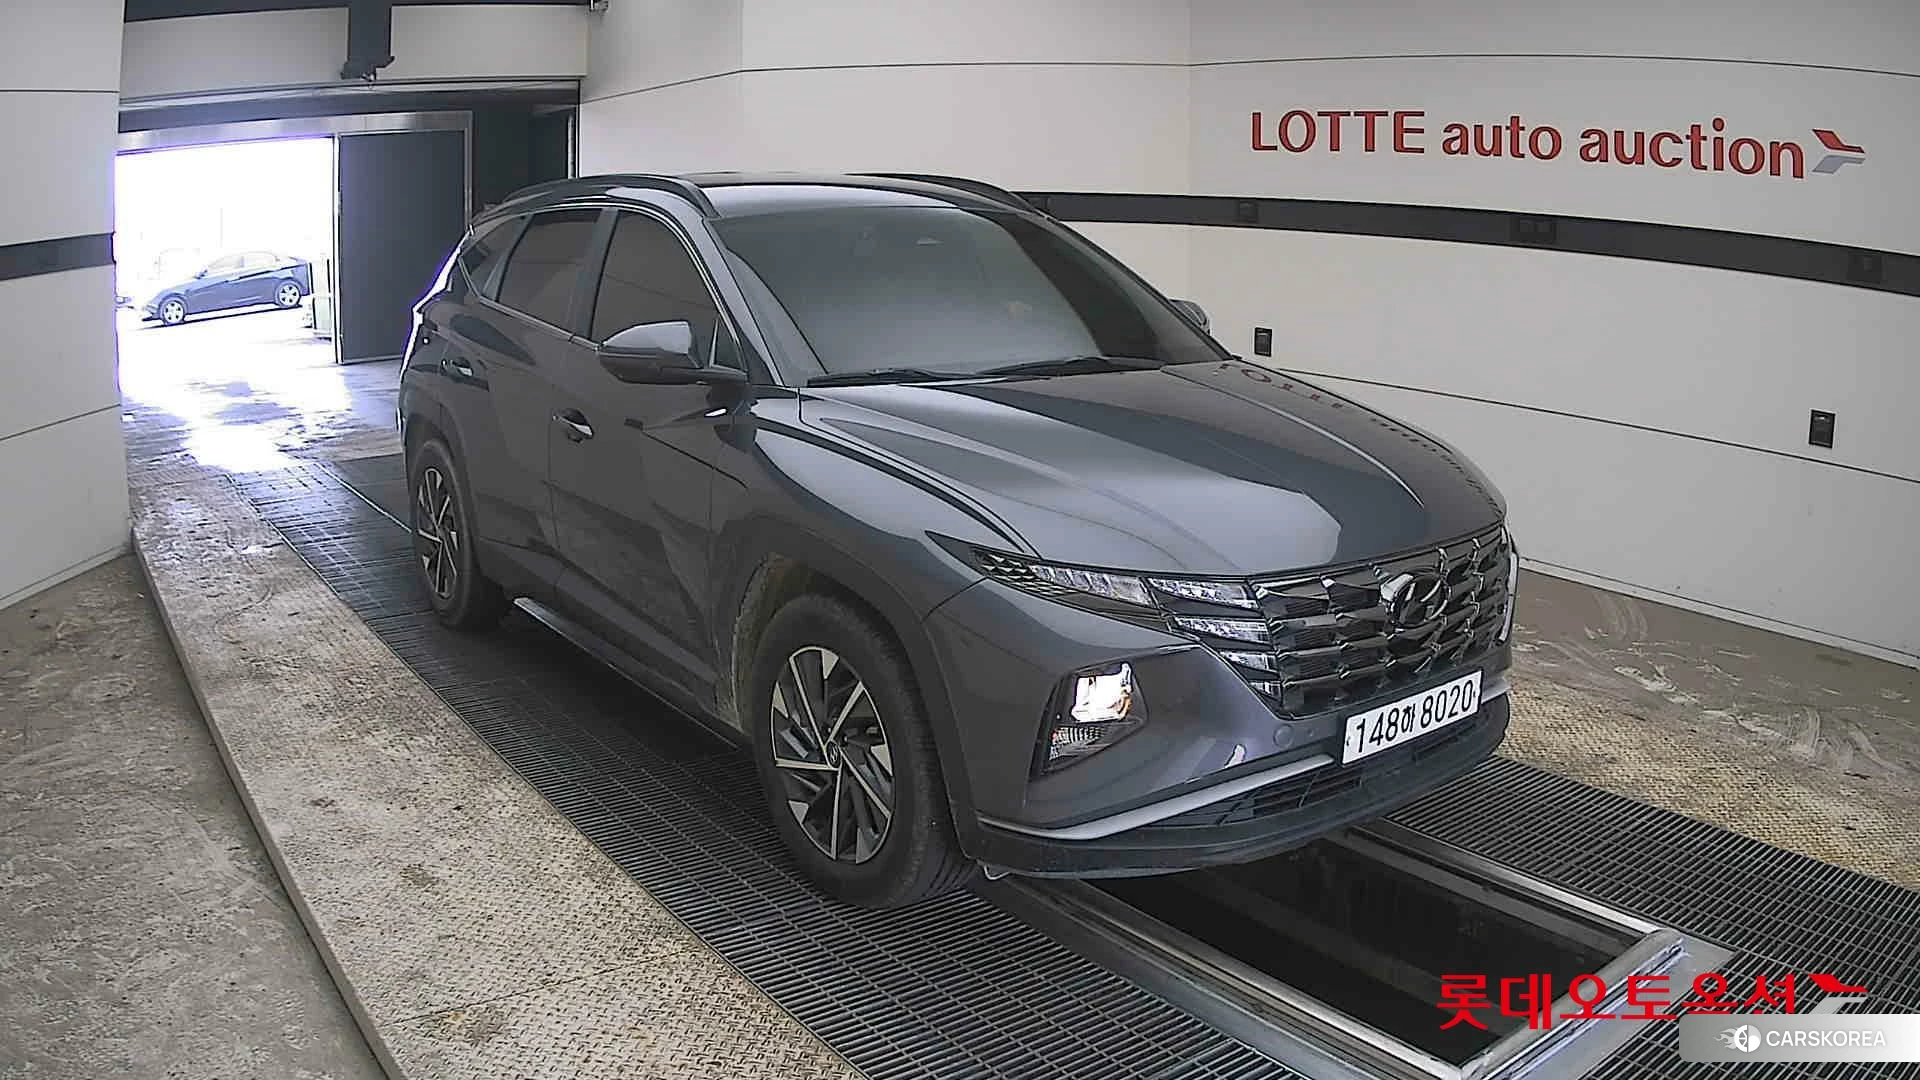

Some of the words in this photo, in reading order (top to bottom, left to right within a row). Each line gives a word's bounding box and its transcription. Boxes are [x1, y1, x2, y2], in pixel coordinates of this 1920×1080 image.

[1251, 110, 1425, 154] LOTTE
[1441, 116, 1562, 162] auto
[1579, 117, 1806, 179] auction
[1356, 703, 1416, 752] 148하
[1420, 679, 1474, 729] 8020
